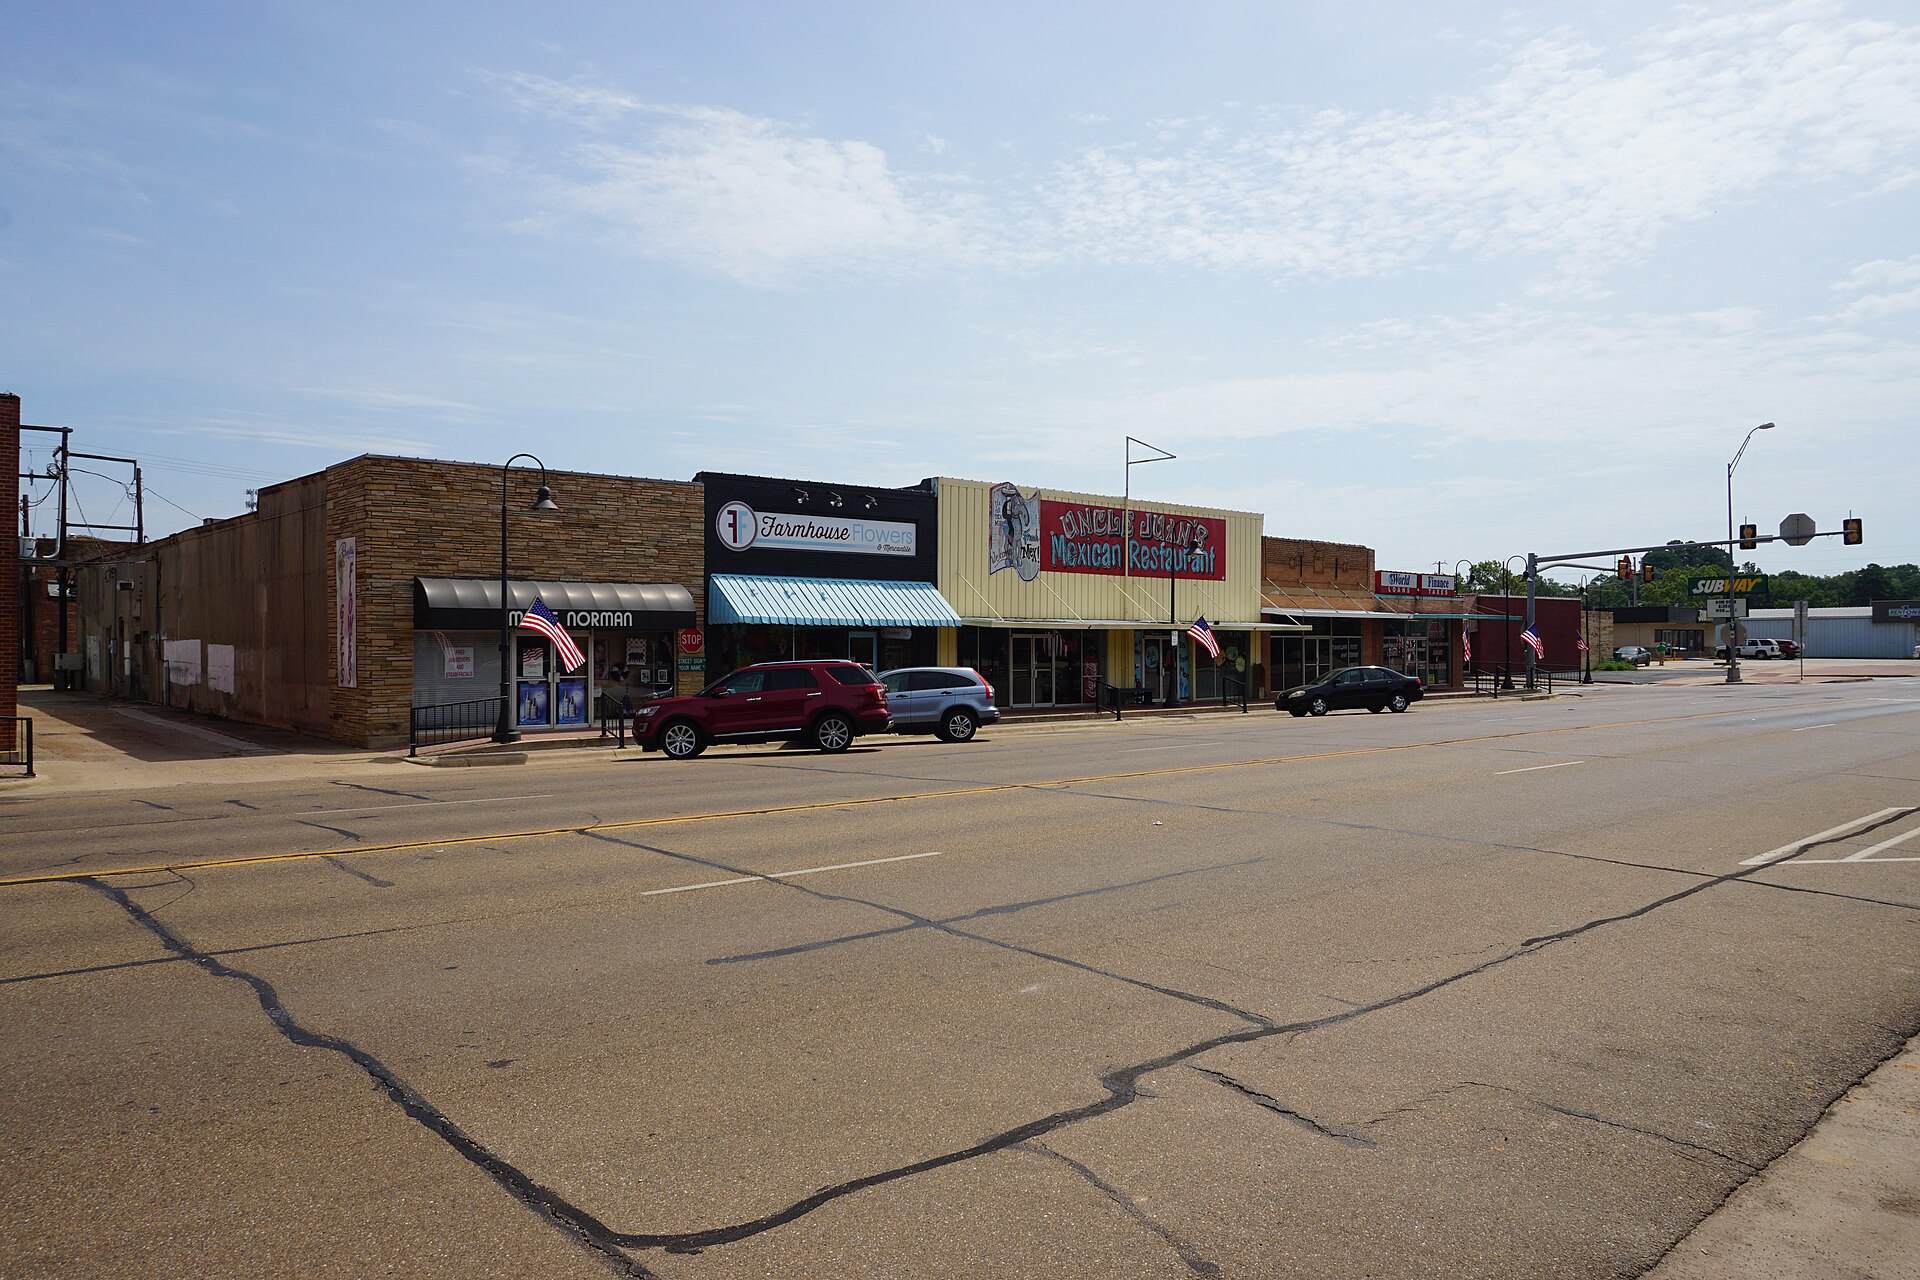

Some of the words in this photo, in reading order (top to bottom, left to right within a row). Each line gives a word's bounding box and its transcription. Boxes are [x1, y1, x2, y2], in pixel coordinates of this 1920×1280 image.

[761, 515, 850, 541] Farmhouse
[852, 523, 913, 545] Flowers
[1060, 507, 1135, 539] UNCLE
[1050, 531, 1123, 569] Mexican
[1128, 539, 1215, 575] Restaurant
[1393, 574, 1411, 586] World
[1427, 575, 1449, 589] Finance
[1692, 577, 1762, 594] SUBWAY
[566, 611, 633, 627] NORMAN
[681, 634, 702, 645] STOP
